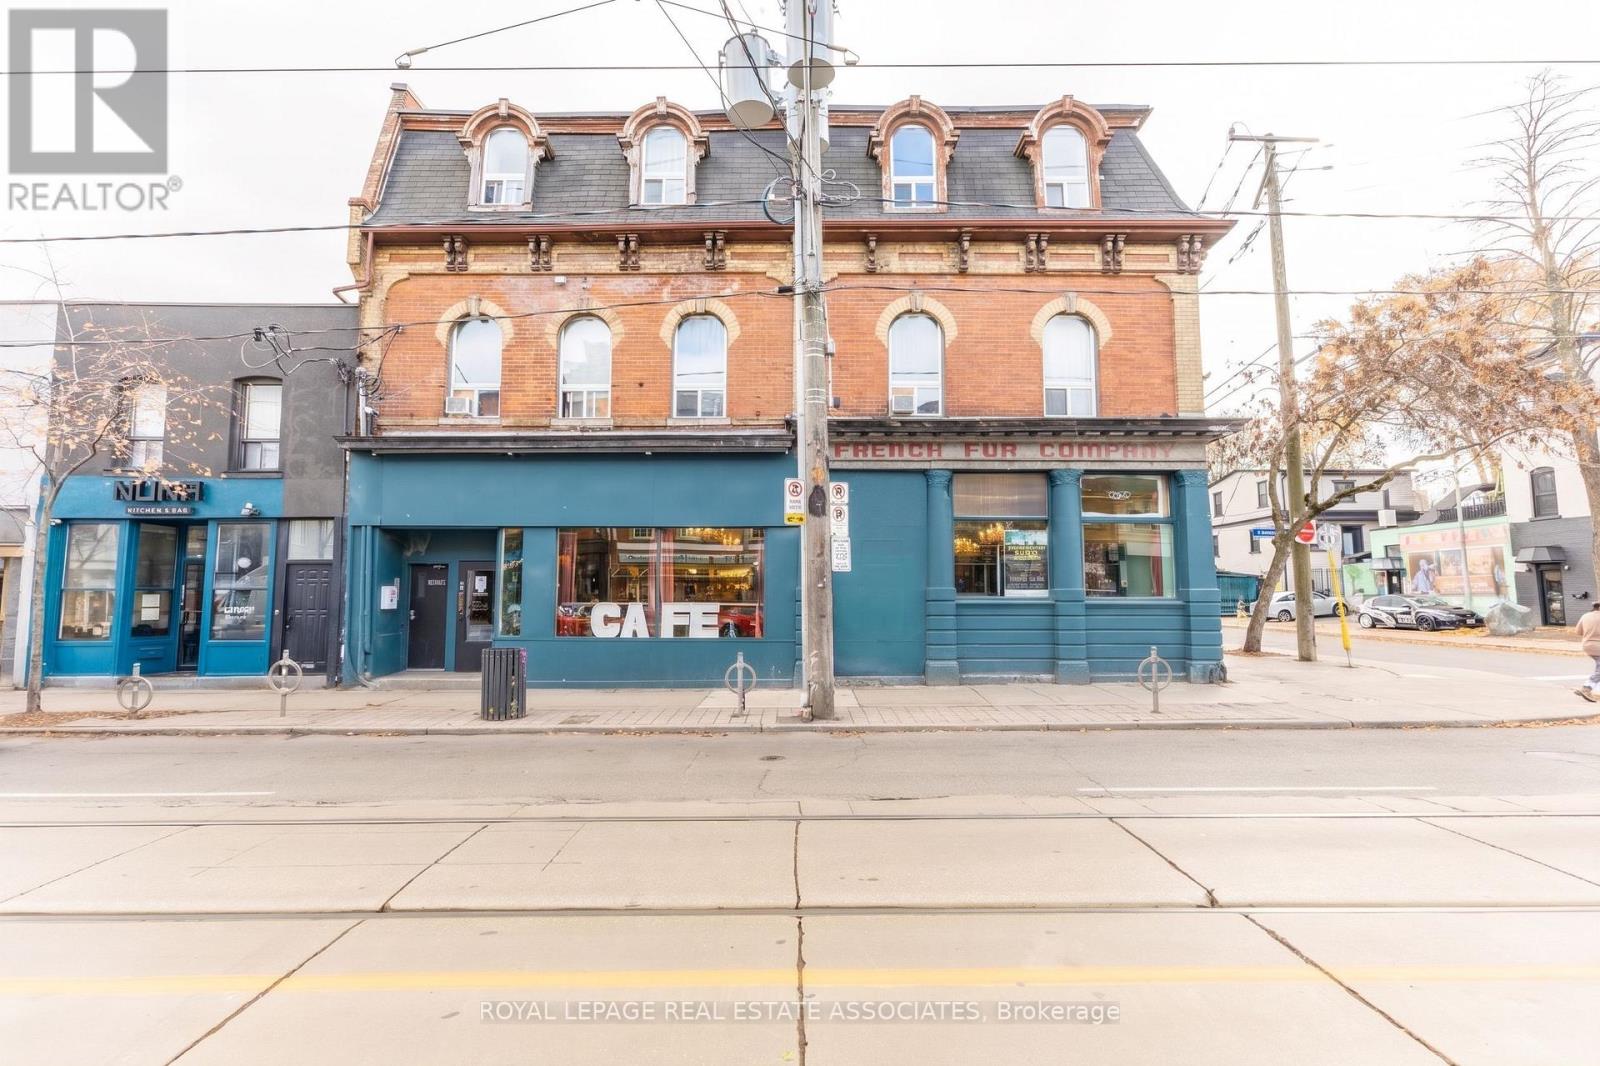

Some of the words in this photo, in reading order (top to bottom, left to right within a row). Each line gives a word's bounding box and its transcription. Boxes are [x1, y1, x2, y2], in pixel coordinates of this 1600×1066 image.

[834, 442, 942, 458] FRENCH
[964, 442, 1018, 458] FUR
[1039, 442, 1174, 458] COMPANY
[591, 602, 720, 639] CAFE
